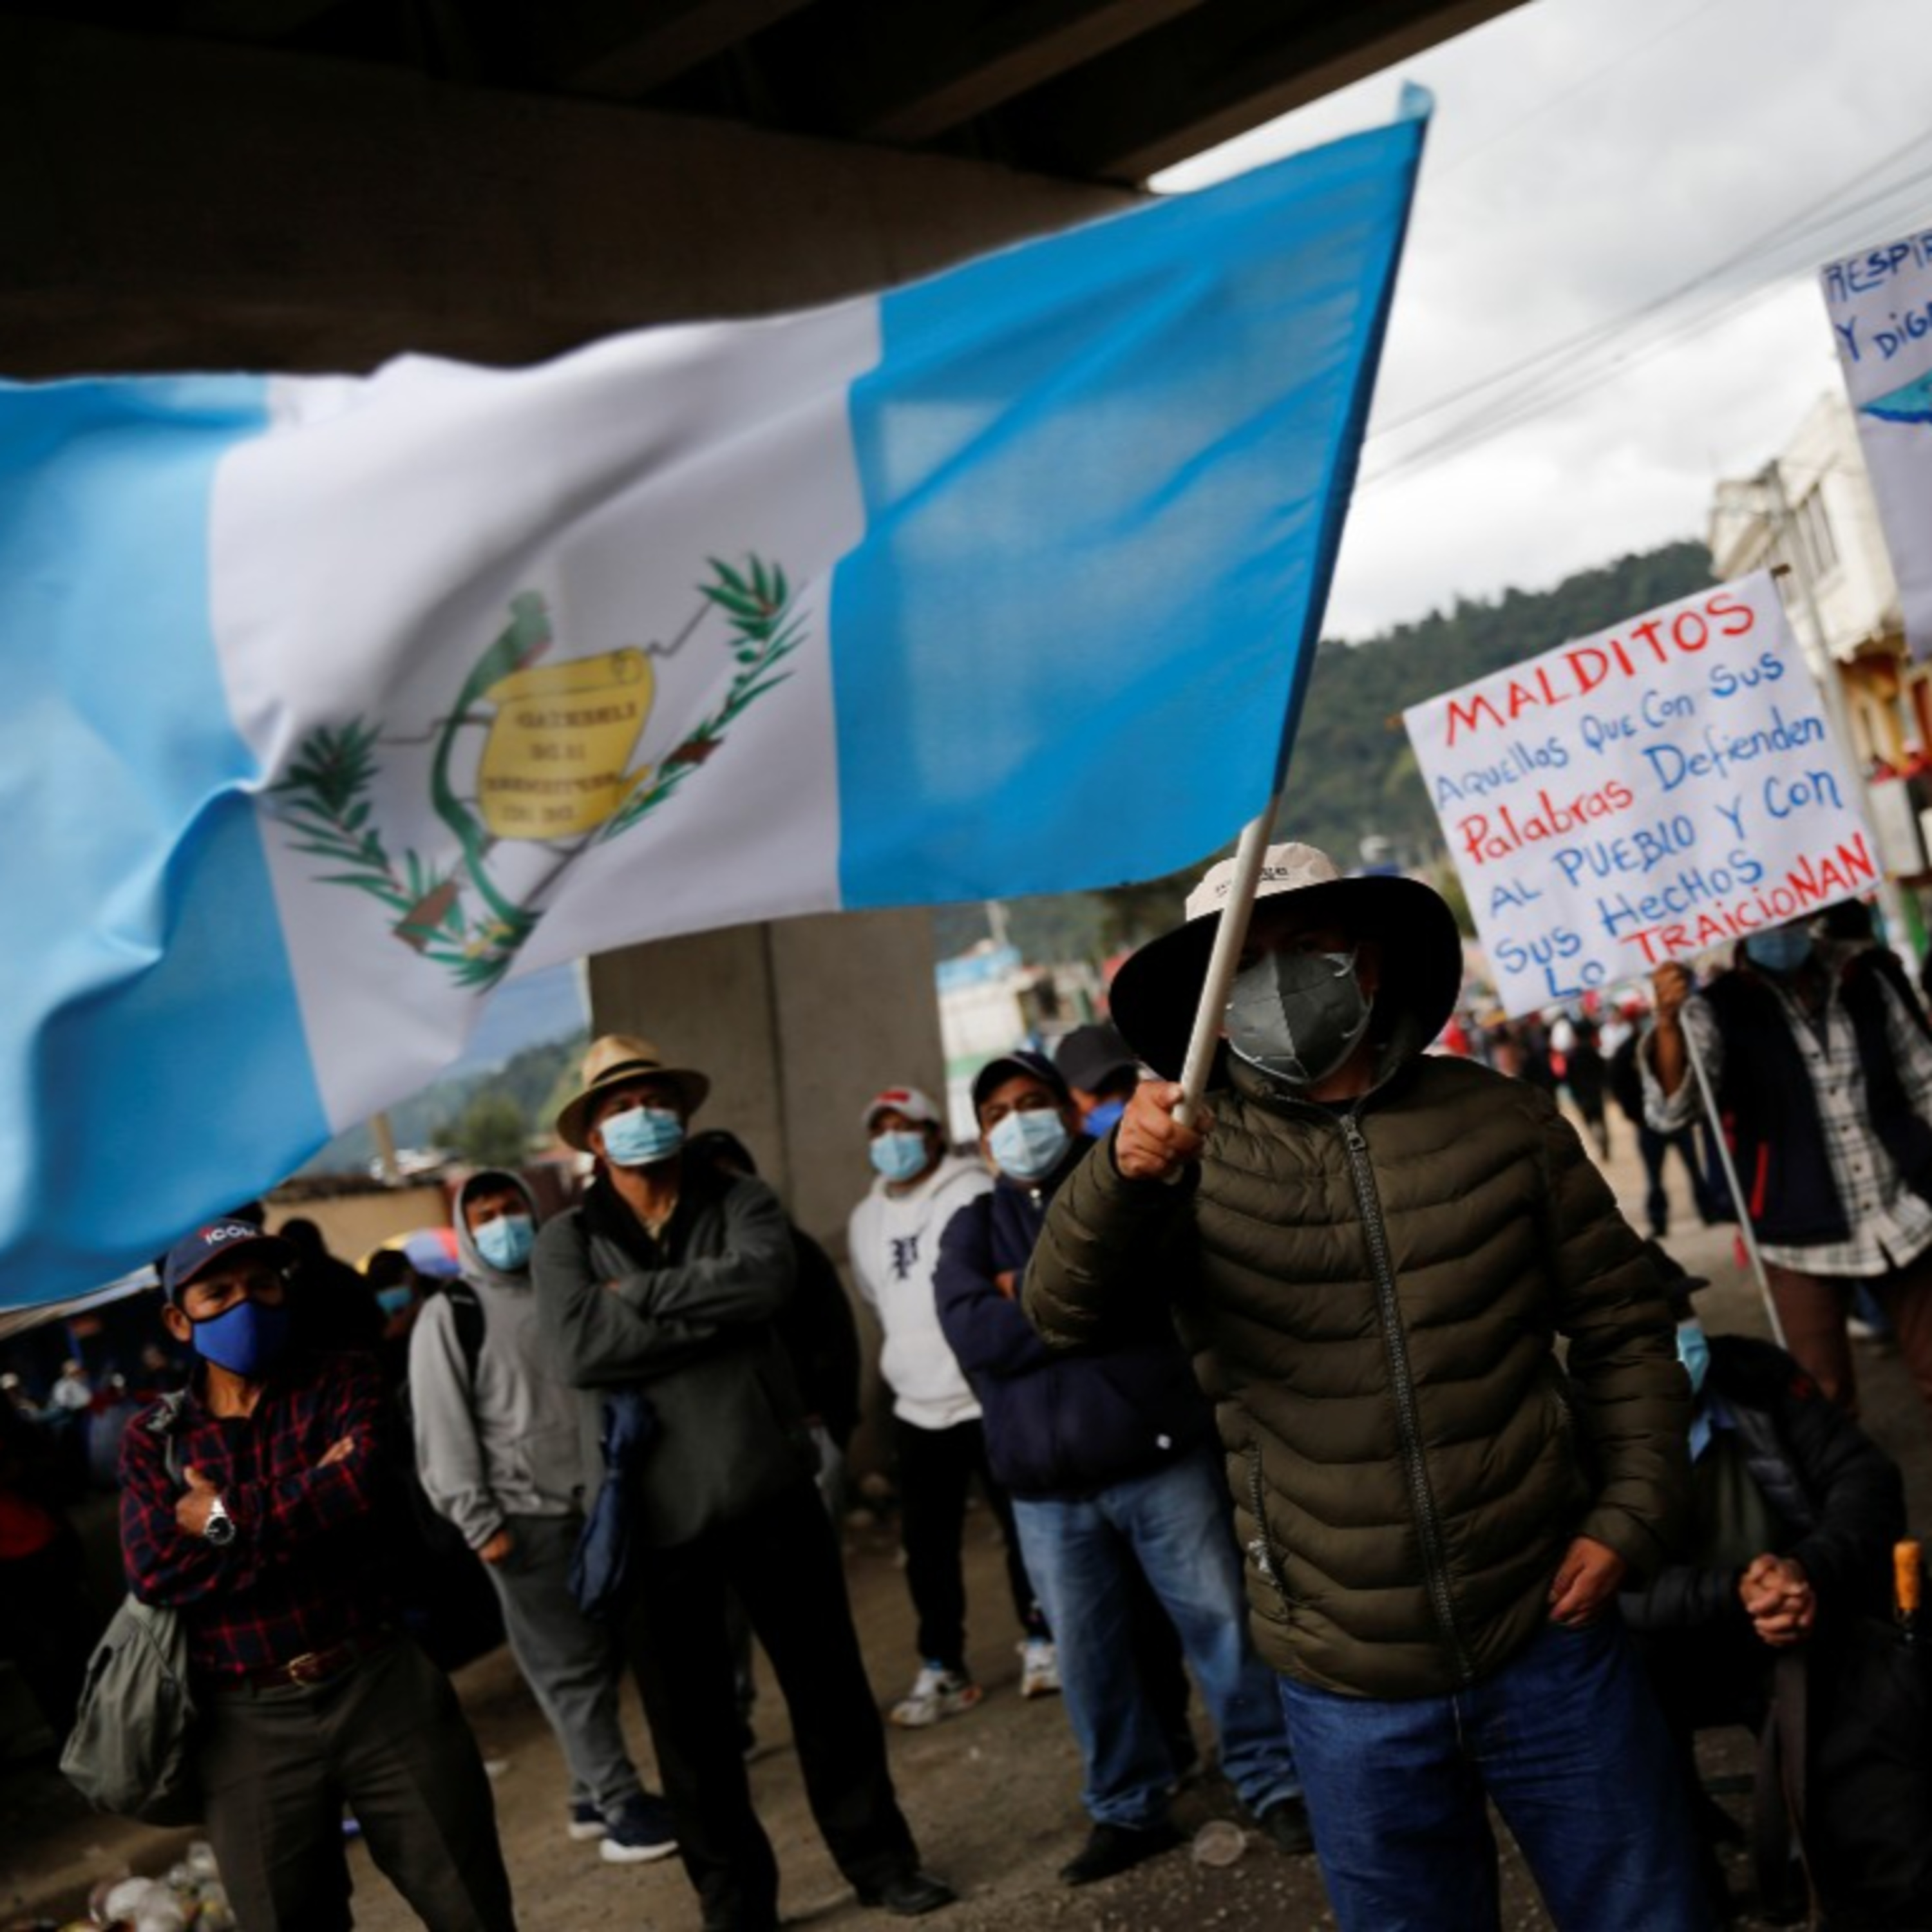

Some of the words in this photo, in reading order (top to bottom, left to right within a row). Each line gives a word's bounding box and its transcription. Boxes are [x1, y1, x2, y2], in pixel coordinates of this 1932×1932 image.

[1835, 315, 1861, 362] Y
[1448, 593, 1754, 746] MALDITOS
[1643, 690, 1695, 728] Con
[1459, 780, 1634, 864] Palabras
[1642, 706, 1824, 791] Defienden
[1490, 880, 1542, 916] AL
[1714, 797, 1745, 840] Y
[1765, 770, 1843, 819] Con
